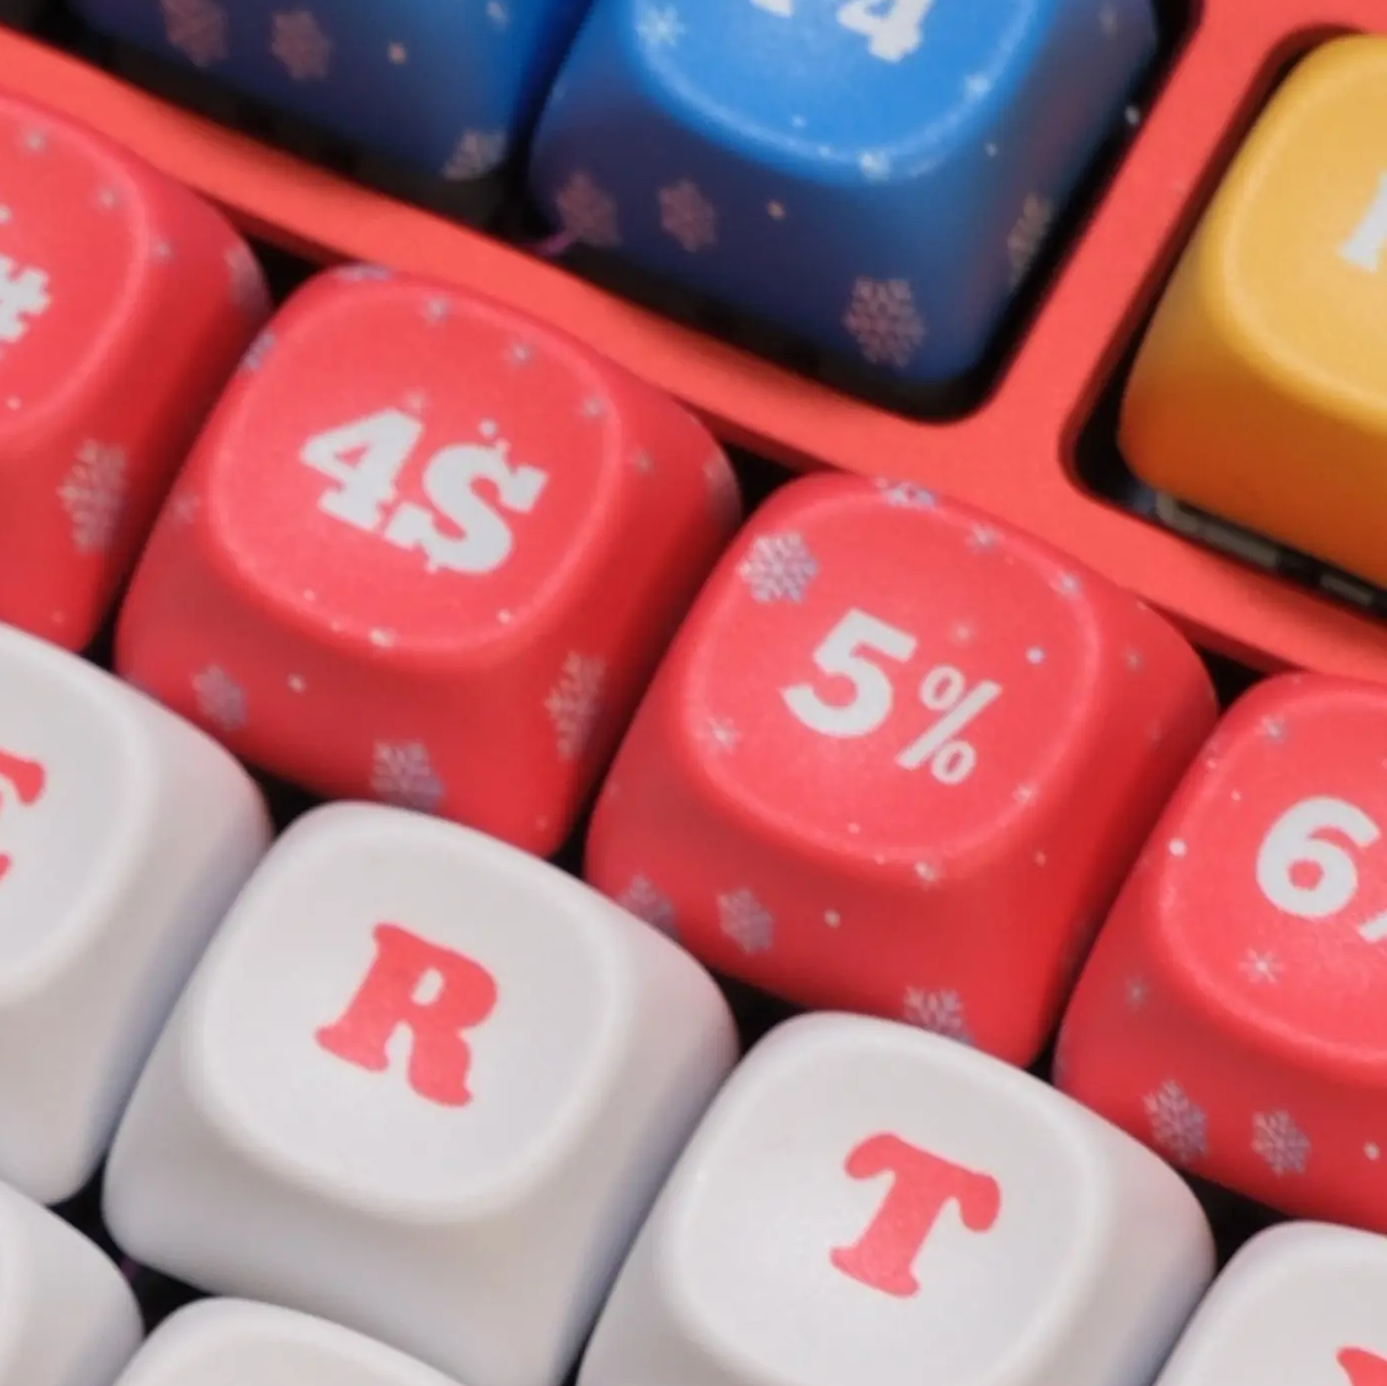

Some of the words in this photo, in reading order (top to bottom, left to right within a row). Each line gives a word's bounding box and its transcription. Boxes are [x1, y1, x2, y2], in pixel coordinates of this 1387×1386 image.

[299, 410, 548, 575] 4$
[781, 609, 1001, 784] 5%
[1256, 795, 1387, 943] 6
[315, 921, 500, 1108] R
[830, 1131, 1002, 1298] T
